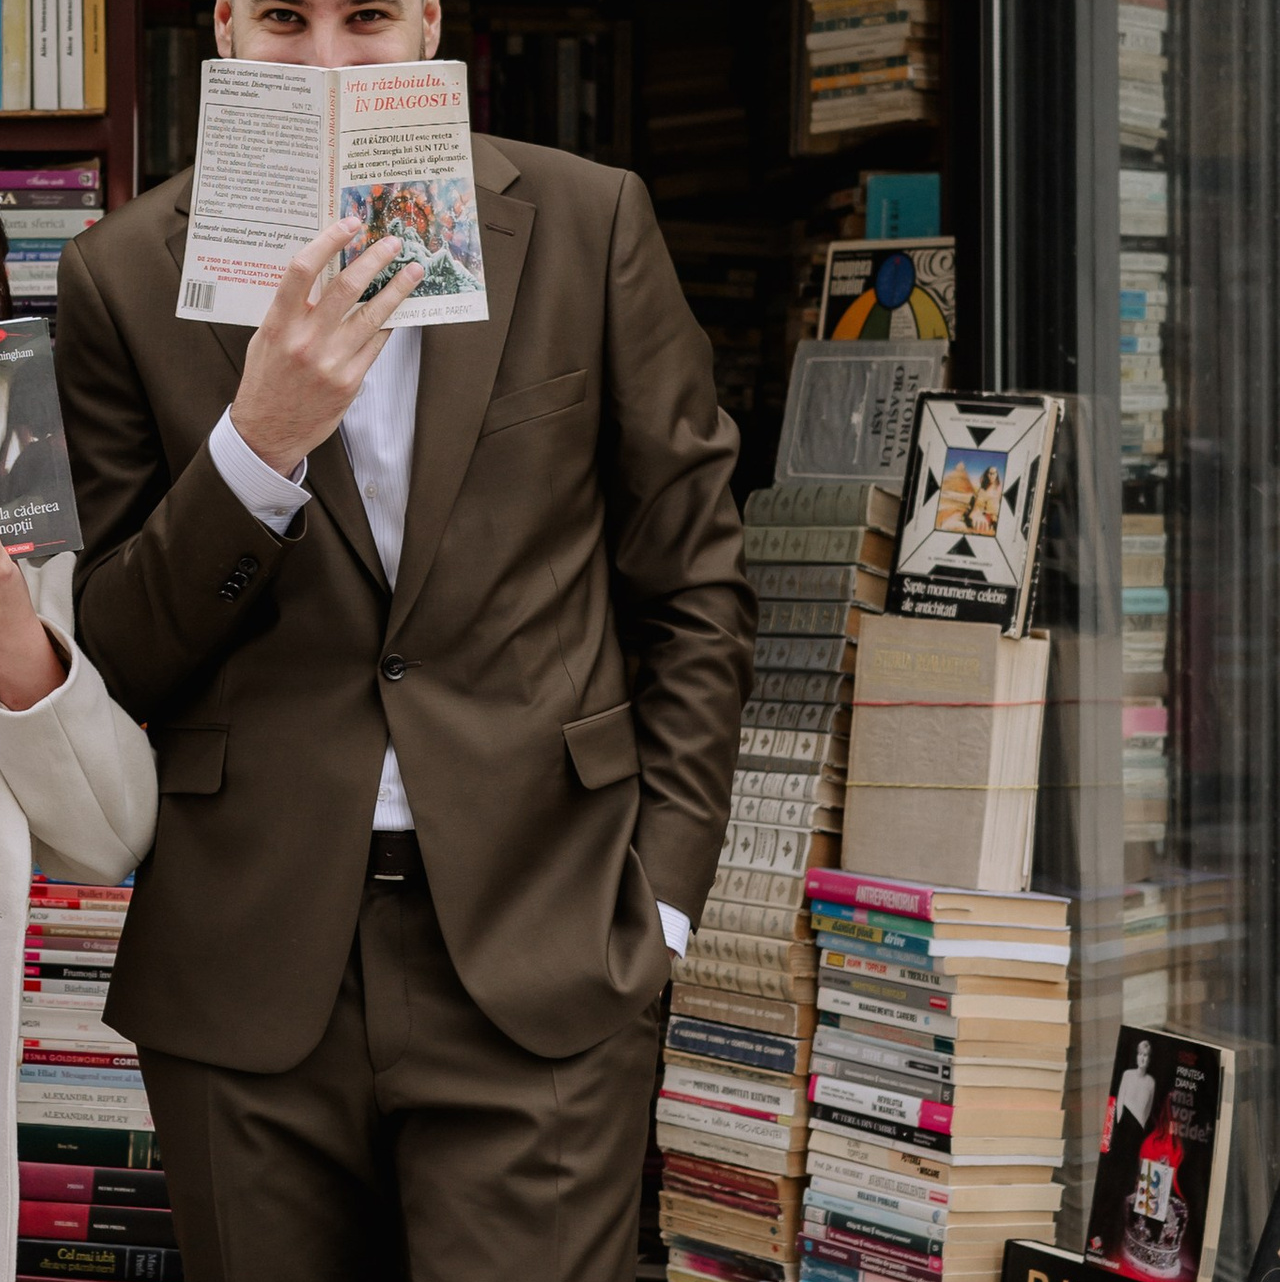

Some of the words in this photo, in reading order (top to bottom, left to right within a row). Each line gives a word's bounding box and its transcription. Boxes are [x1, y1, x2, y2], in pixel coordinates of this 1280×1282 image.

[356, 95, 371, 113] ÎN
[374, 93, 461, 111] DRAGOSTE
[414, 143, 432, 153] SUN
[896, 373, 918, 459] ISTORIA
[0, 507, 11, 521] la
[13, 501, 60, 518] căderea
[926, 583, 976, 601] monumente
[977, 587, 1008, 605] celebre
[901, 597, 914, 612] ale
[856, 885, 920, 913] ANTREPRENORIAT
[42, 1091, 94, 1102] ALEXANDRA
[42, 1111, 94, 1121] ALEXANDRA
